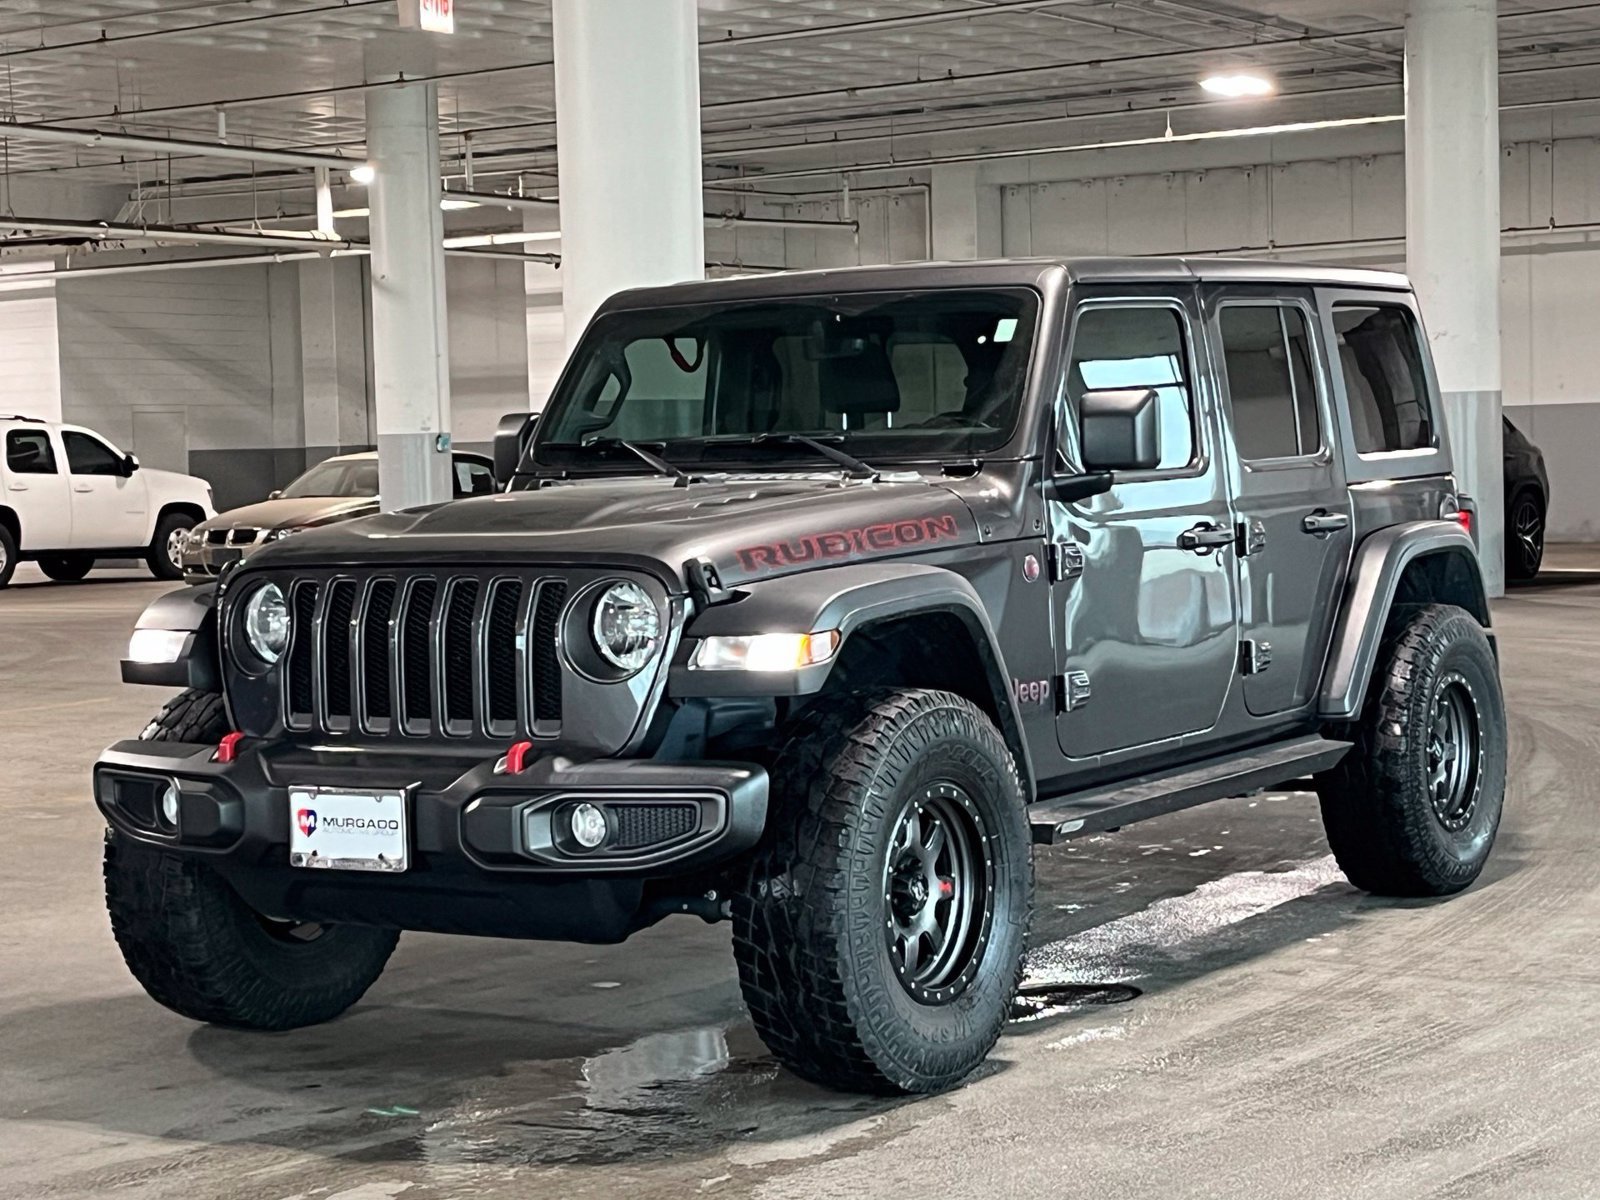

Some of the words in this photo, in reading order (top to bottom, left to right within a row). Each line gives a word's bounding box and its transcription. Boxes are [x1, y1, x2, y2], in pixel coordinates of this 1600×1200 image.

[736, 515, 959, 571] RUBICON
[1012, 678, 1050, 706] Jeep
[323, 817, 399, 829] MURGADO
